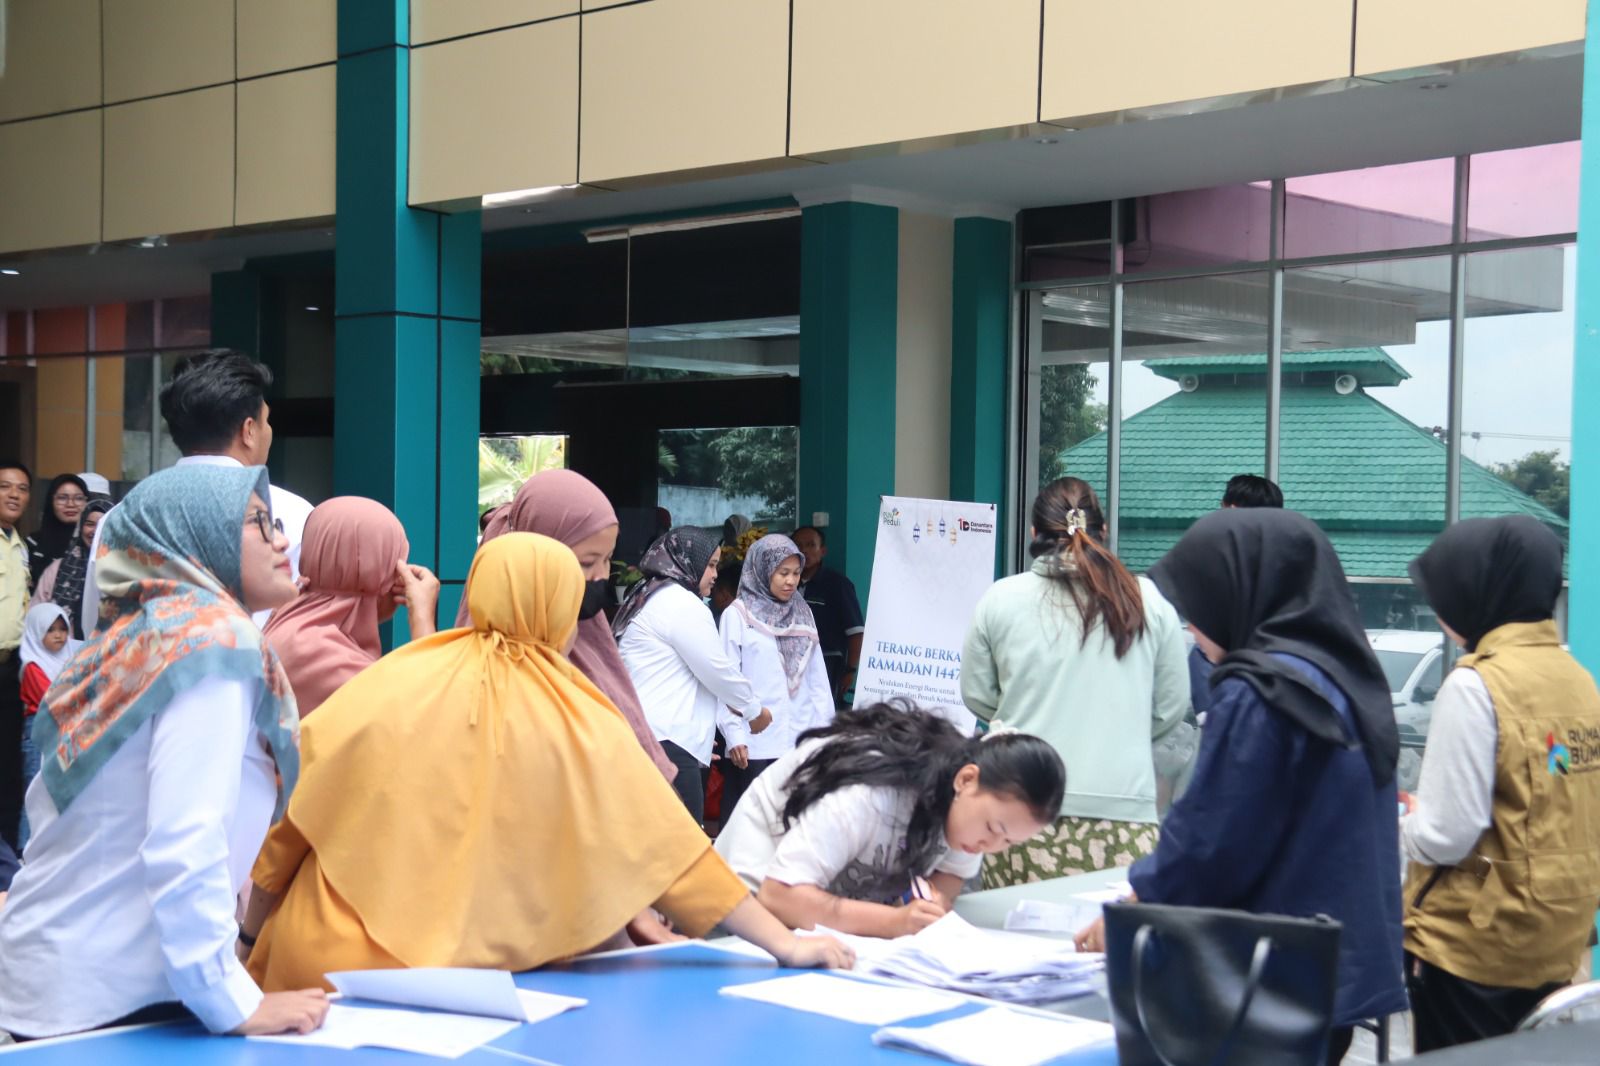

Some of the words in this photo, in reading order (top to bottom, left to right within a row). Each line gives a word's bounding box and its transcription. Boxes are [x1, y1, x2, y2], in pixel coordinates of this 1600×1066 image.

[970, 521, 993, 529] Danantara
[876, 640, 922, 658] TERANG
[924, 647, 961, 663] BERKA
[867, 656, 933, 677] RAMADAN
[935, 665, 961, 681] 1447
[904, 682, 923, 692] Energi
[939, 687, 956, 696] untuk
[1568, 726, 1600, 744] RUMA
[1570, 746, 1600, 765] BUM
